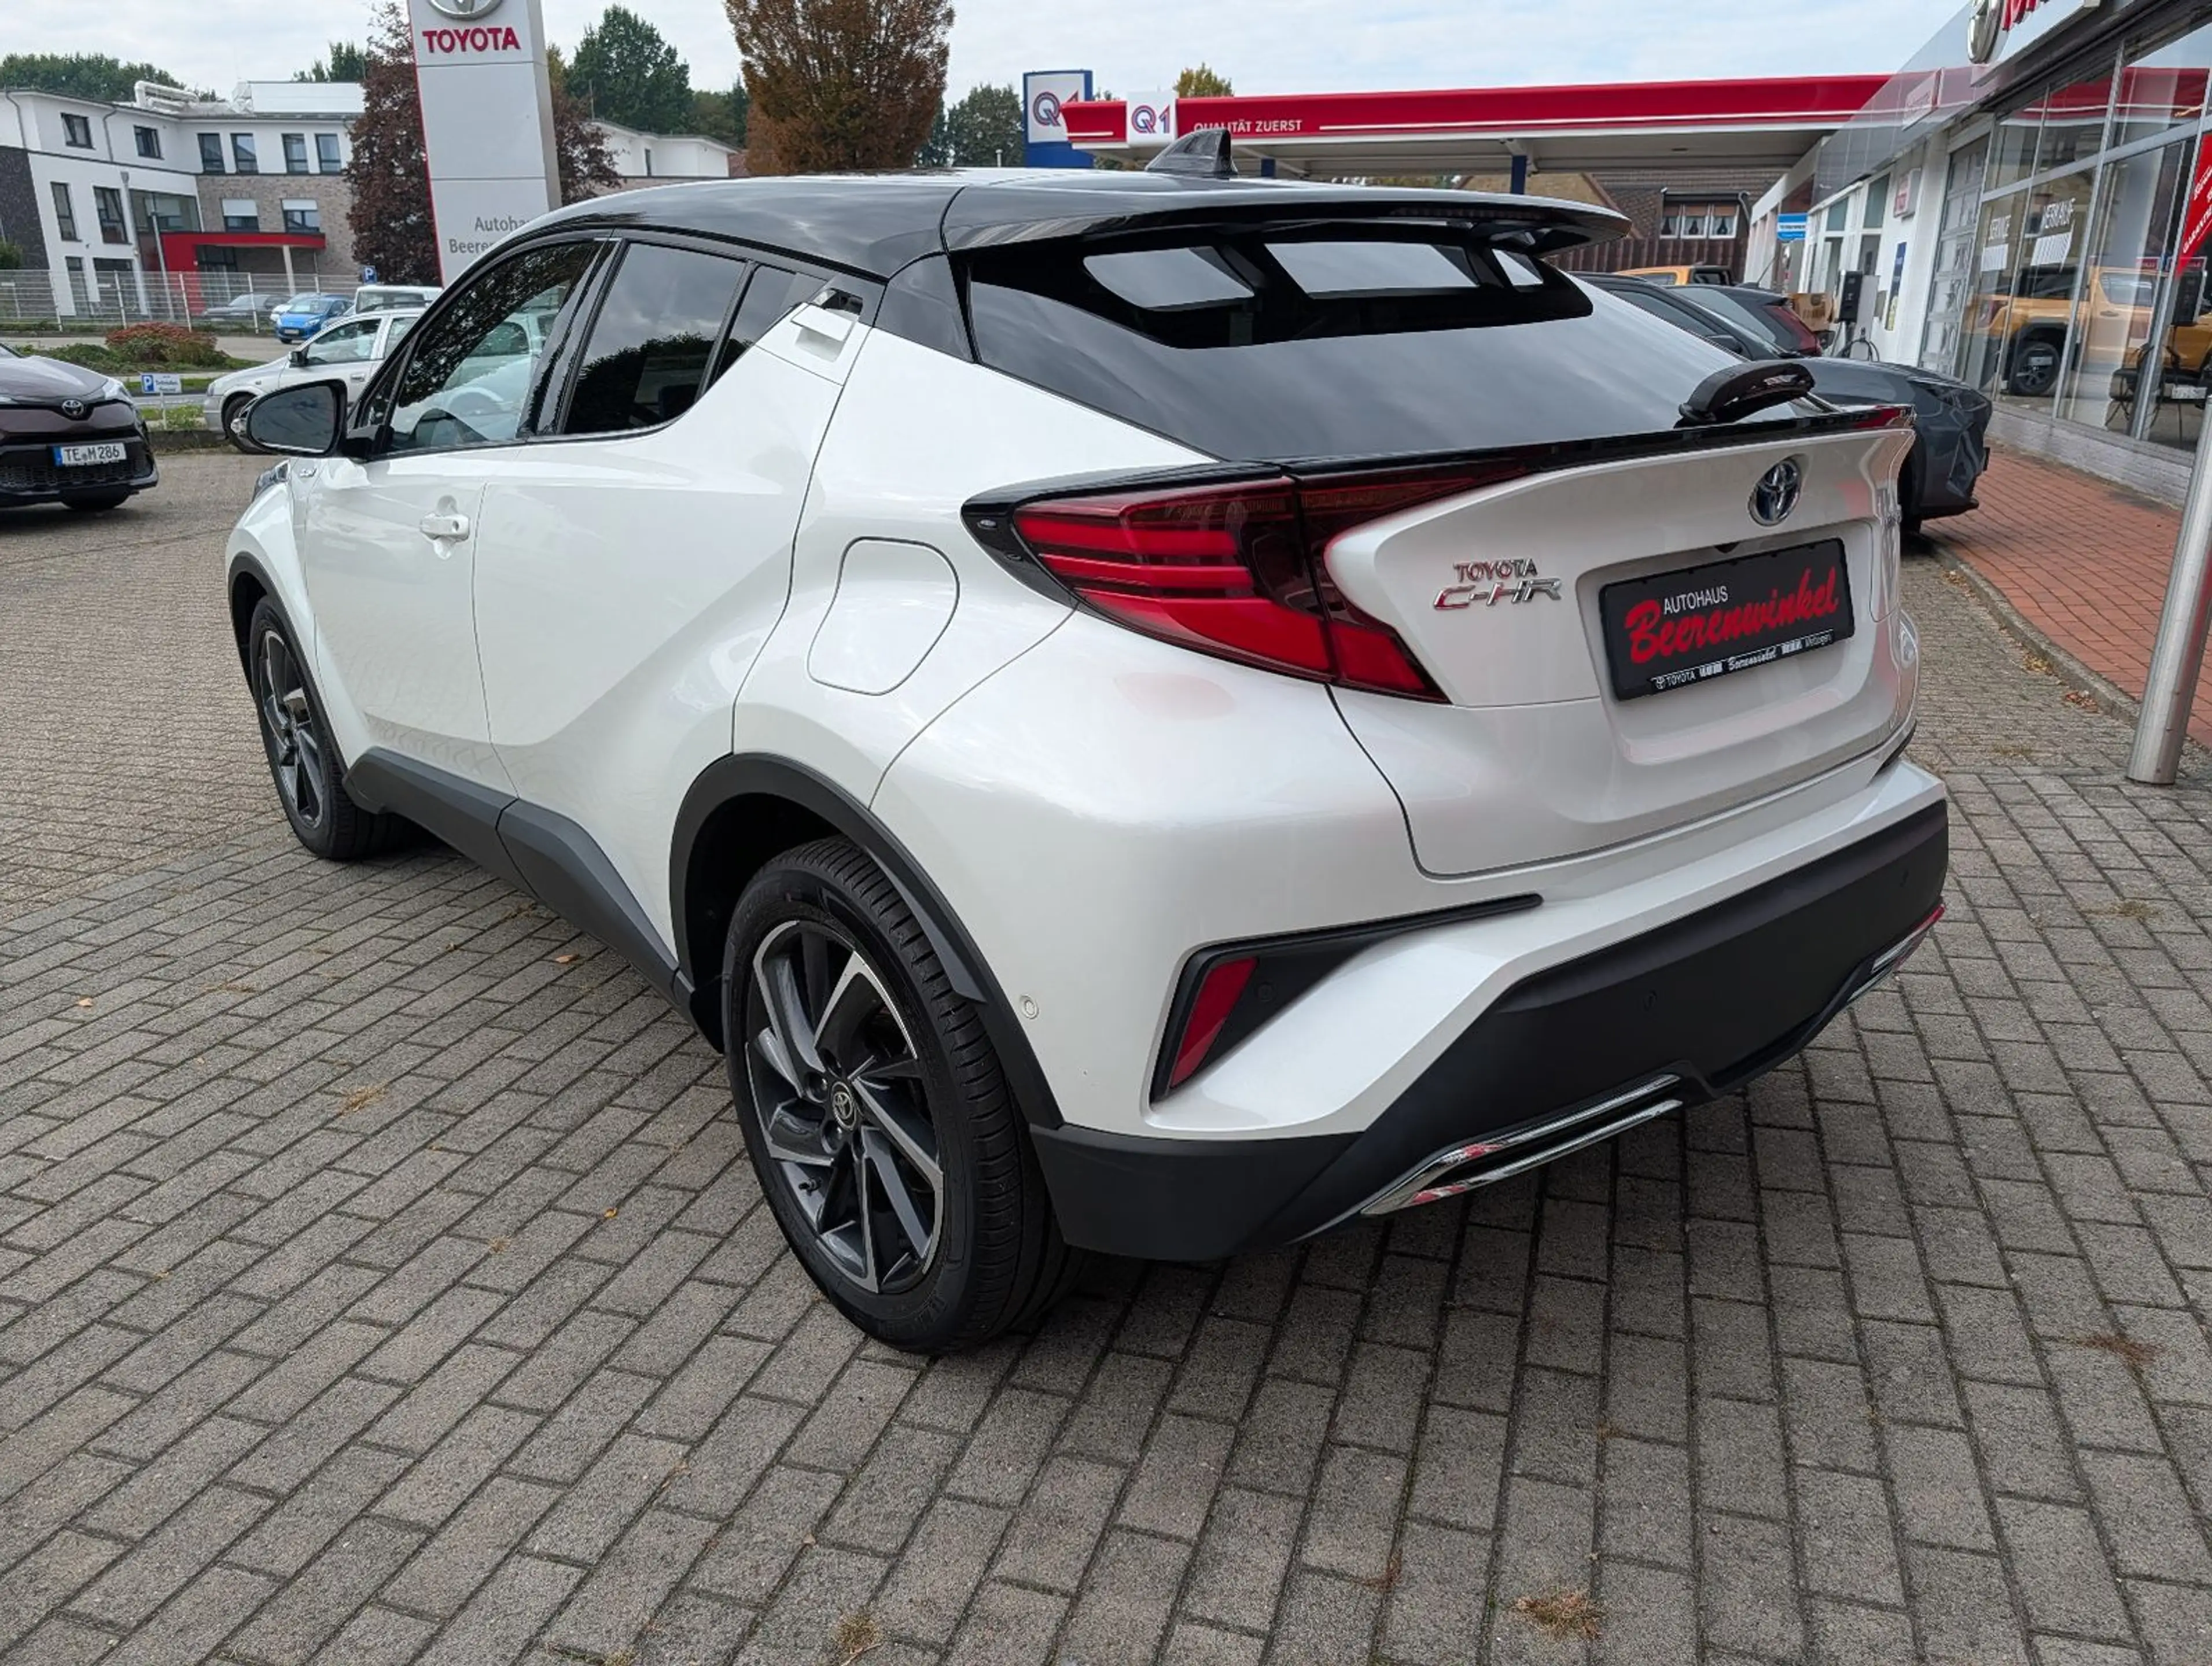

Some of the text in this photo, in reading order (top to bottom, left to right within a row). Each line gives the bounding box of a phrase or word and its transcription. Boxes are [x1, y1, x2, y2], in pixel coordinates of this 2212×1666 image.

[422, 27, 521, 53] TOYOTA
[1132, 104, 1170, 134] Q1
[1256, 120, 1302, 132] ZUERST
[449, 239, 494, 253] Beere
[365, 267, 374, 281] P
[143, 377, 152, 392] P
[1453, 558, 1538, 582] TOYOTA
[1434, 577, 1562, 610] C-HR
[1663, 585, 1729, 615] AUTOHAUS
[1625, 566, 1839, 665] Beerenwinkel
[1666, 670, 1696, 687] TOYOTA
